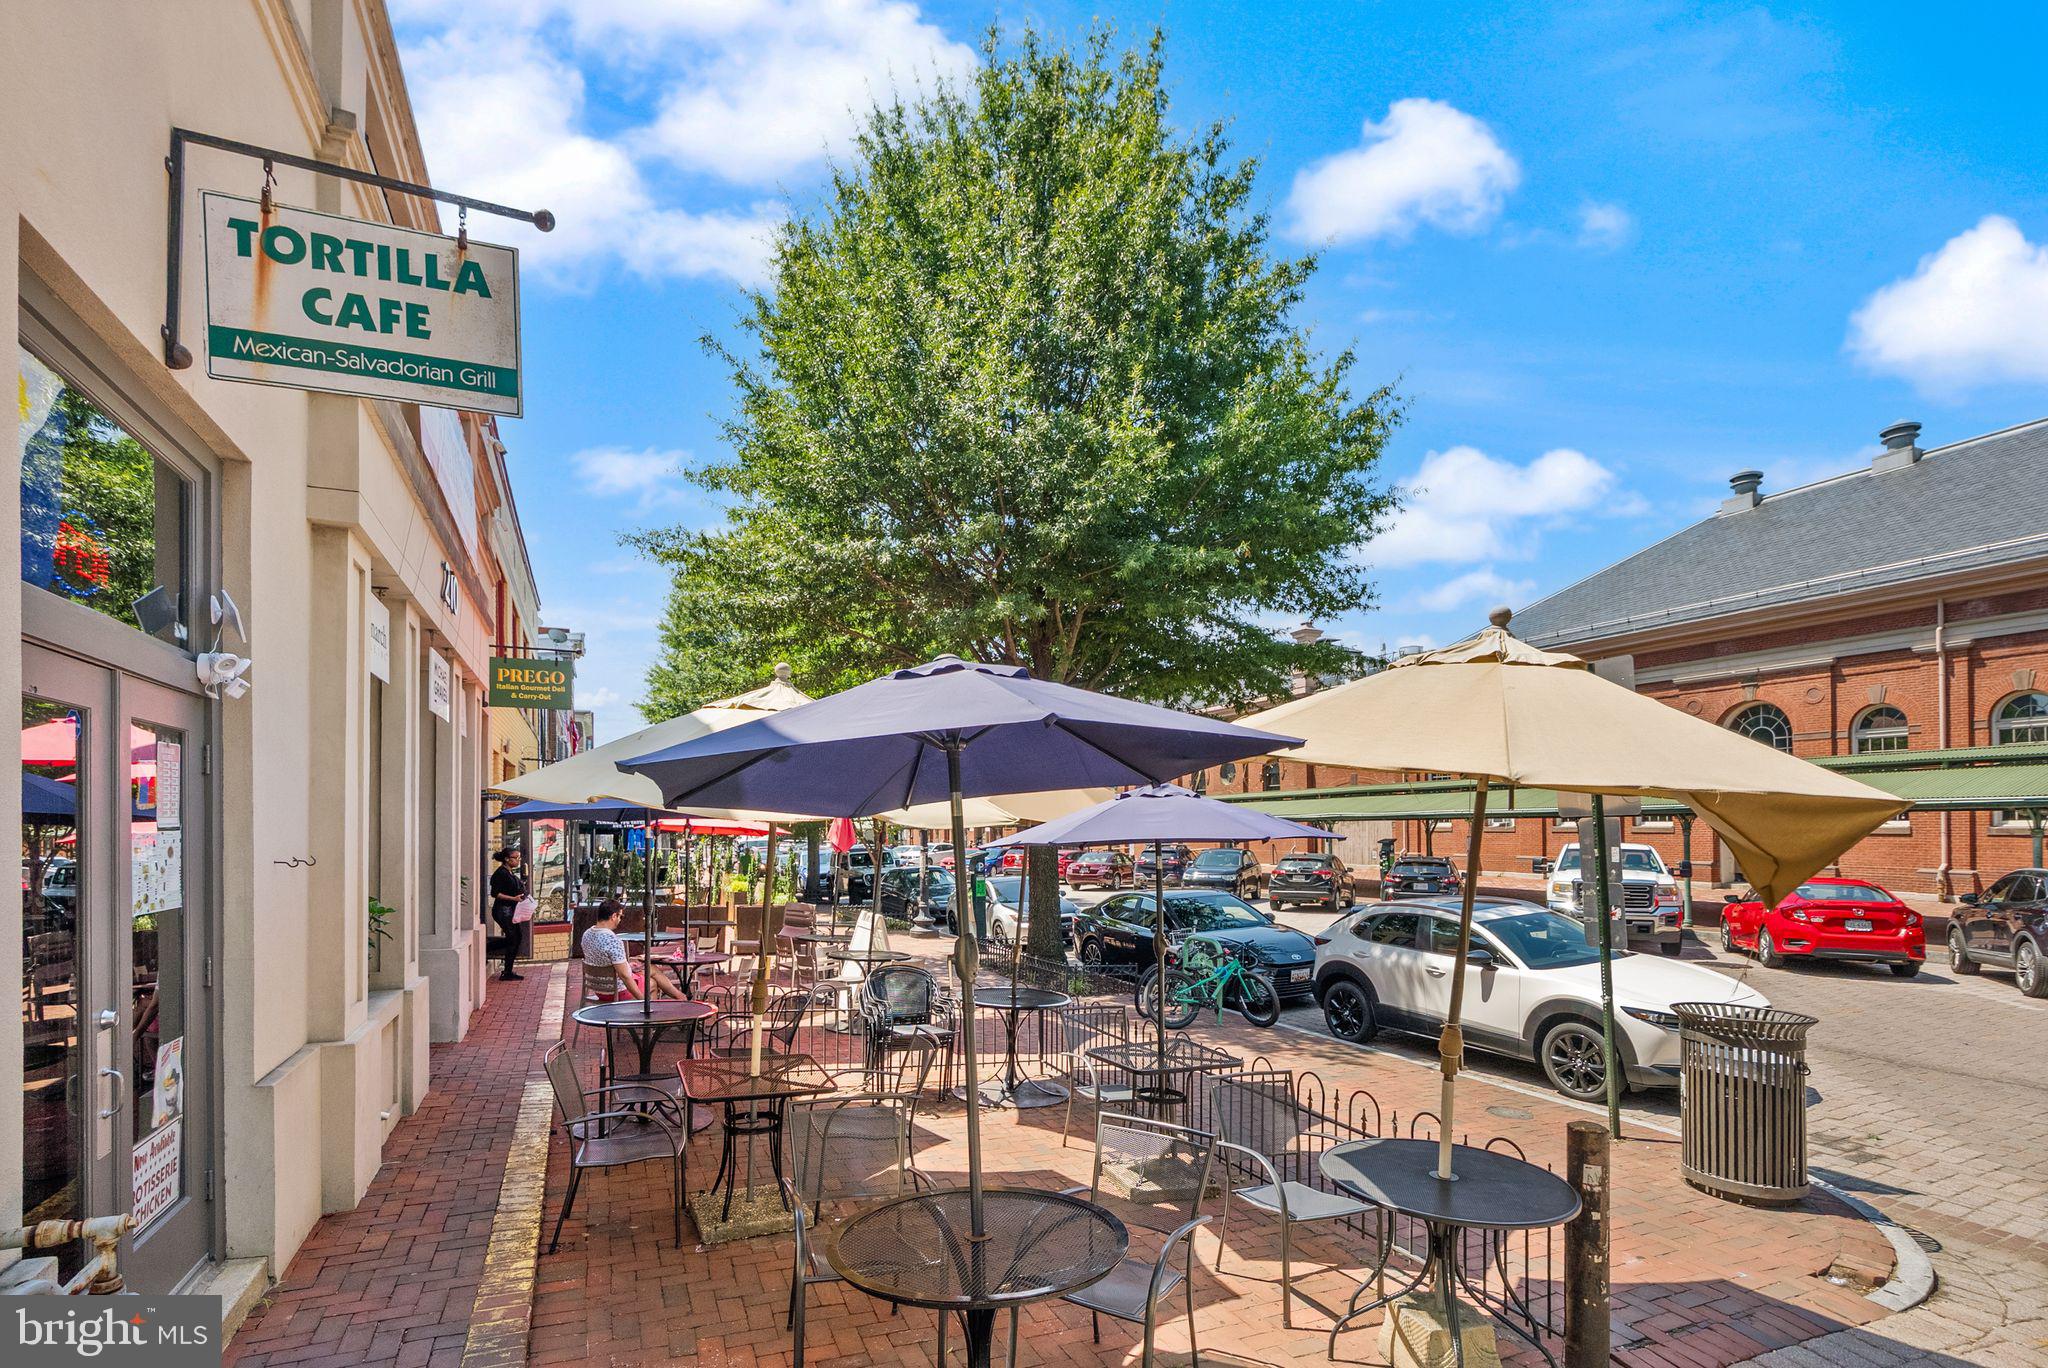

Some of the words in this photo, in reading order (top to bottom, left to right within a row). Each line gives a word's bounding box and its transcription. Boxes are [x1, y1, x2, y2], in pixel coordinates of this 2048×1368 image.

[227, 217, 492, 299] TORTILLA
[302, 288, 432, 340] CAFE
[233, 335, 454, 384] Mexican-Salvadorian
[460, 368, 496, 389] Grill
[496, 683, 519, 691] Italian
[520, 684, 551, 692] Gourmet
[551, 685, 566, 693] Deli
[497, 668, 566, 685] PREGO
[518, 692, 552, 701] Carry-Out
[133, 1151, 148, 1174] Now
[149, 1129, 176, 1159] Available
